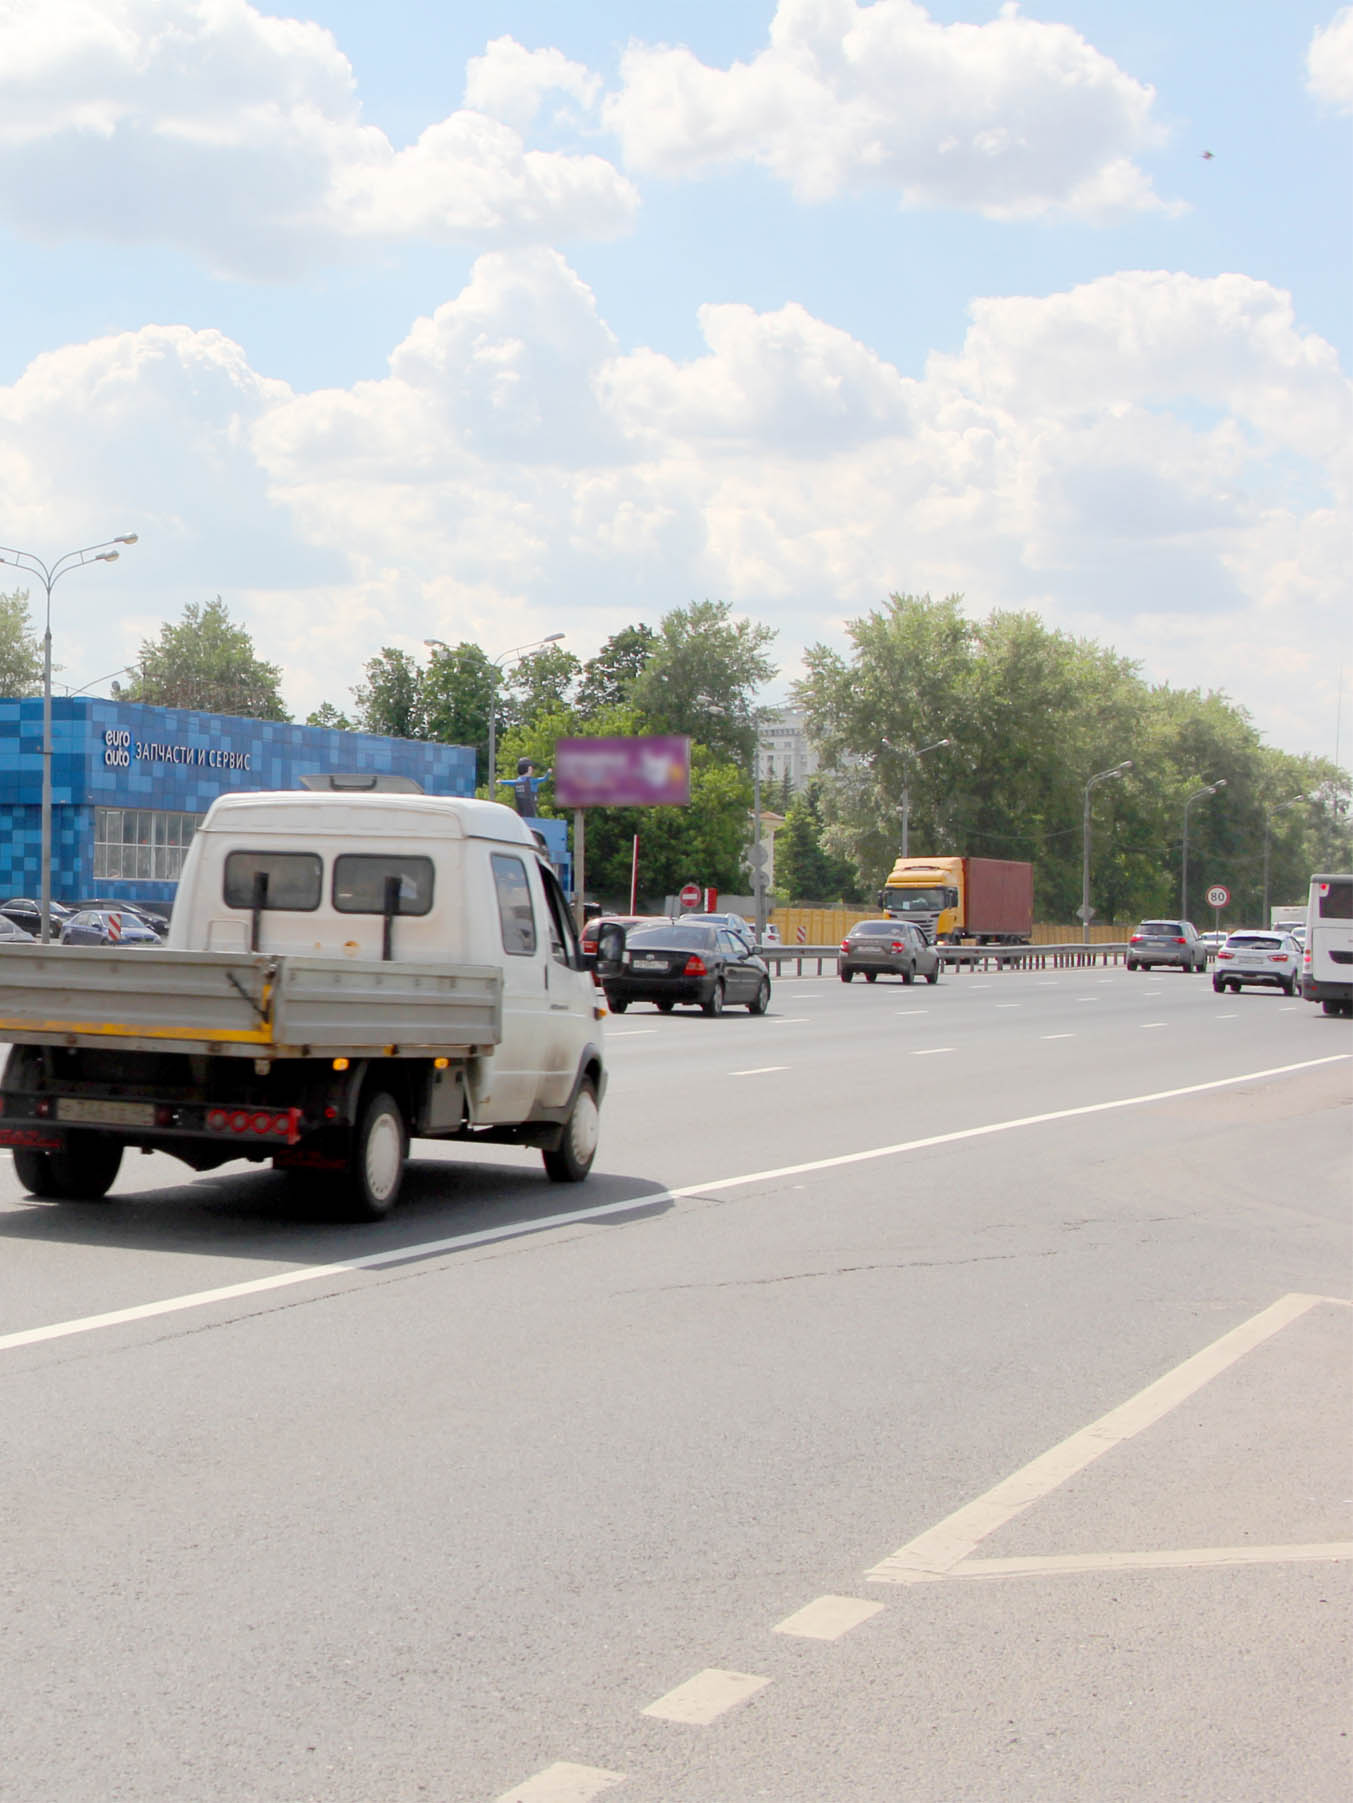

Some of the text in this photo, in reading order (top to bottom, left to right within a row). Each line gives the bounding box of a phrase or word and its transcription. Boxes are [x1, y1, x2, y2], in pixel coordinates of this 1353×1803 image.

[105, 730, 130, 747] euro
[105, 748, 130, 767] auto
[135, 742, 251, 770] ЗАПЧАСТИ И СЕРВИС
[1210, 892, 1225, 901] 80
